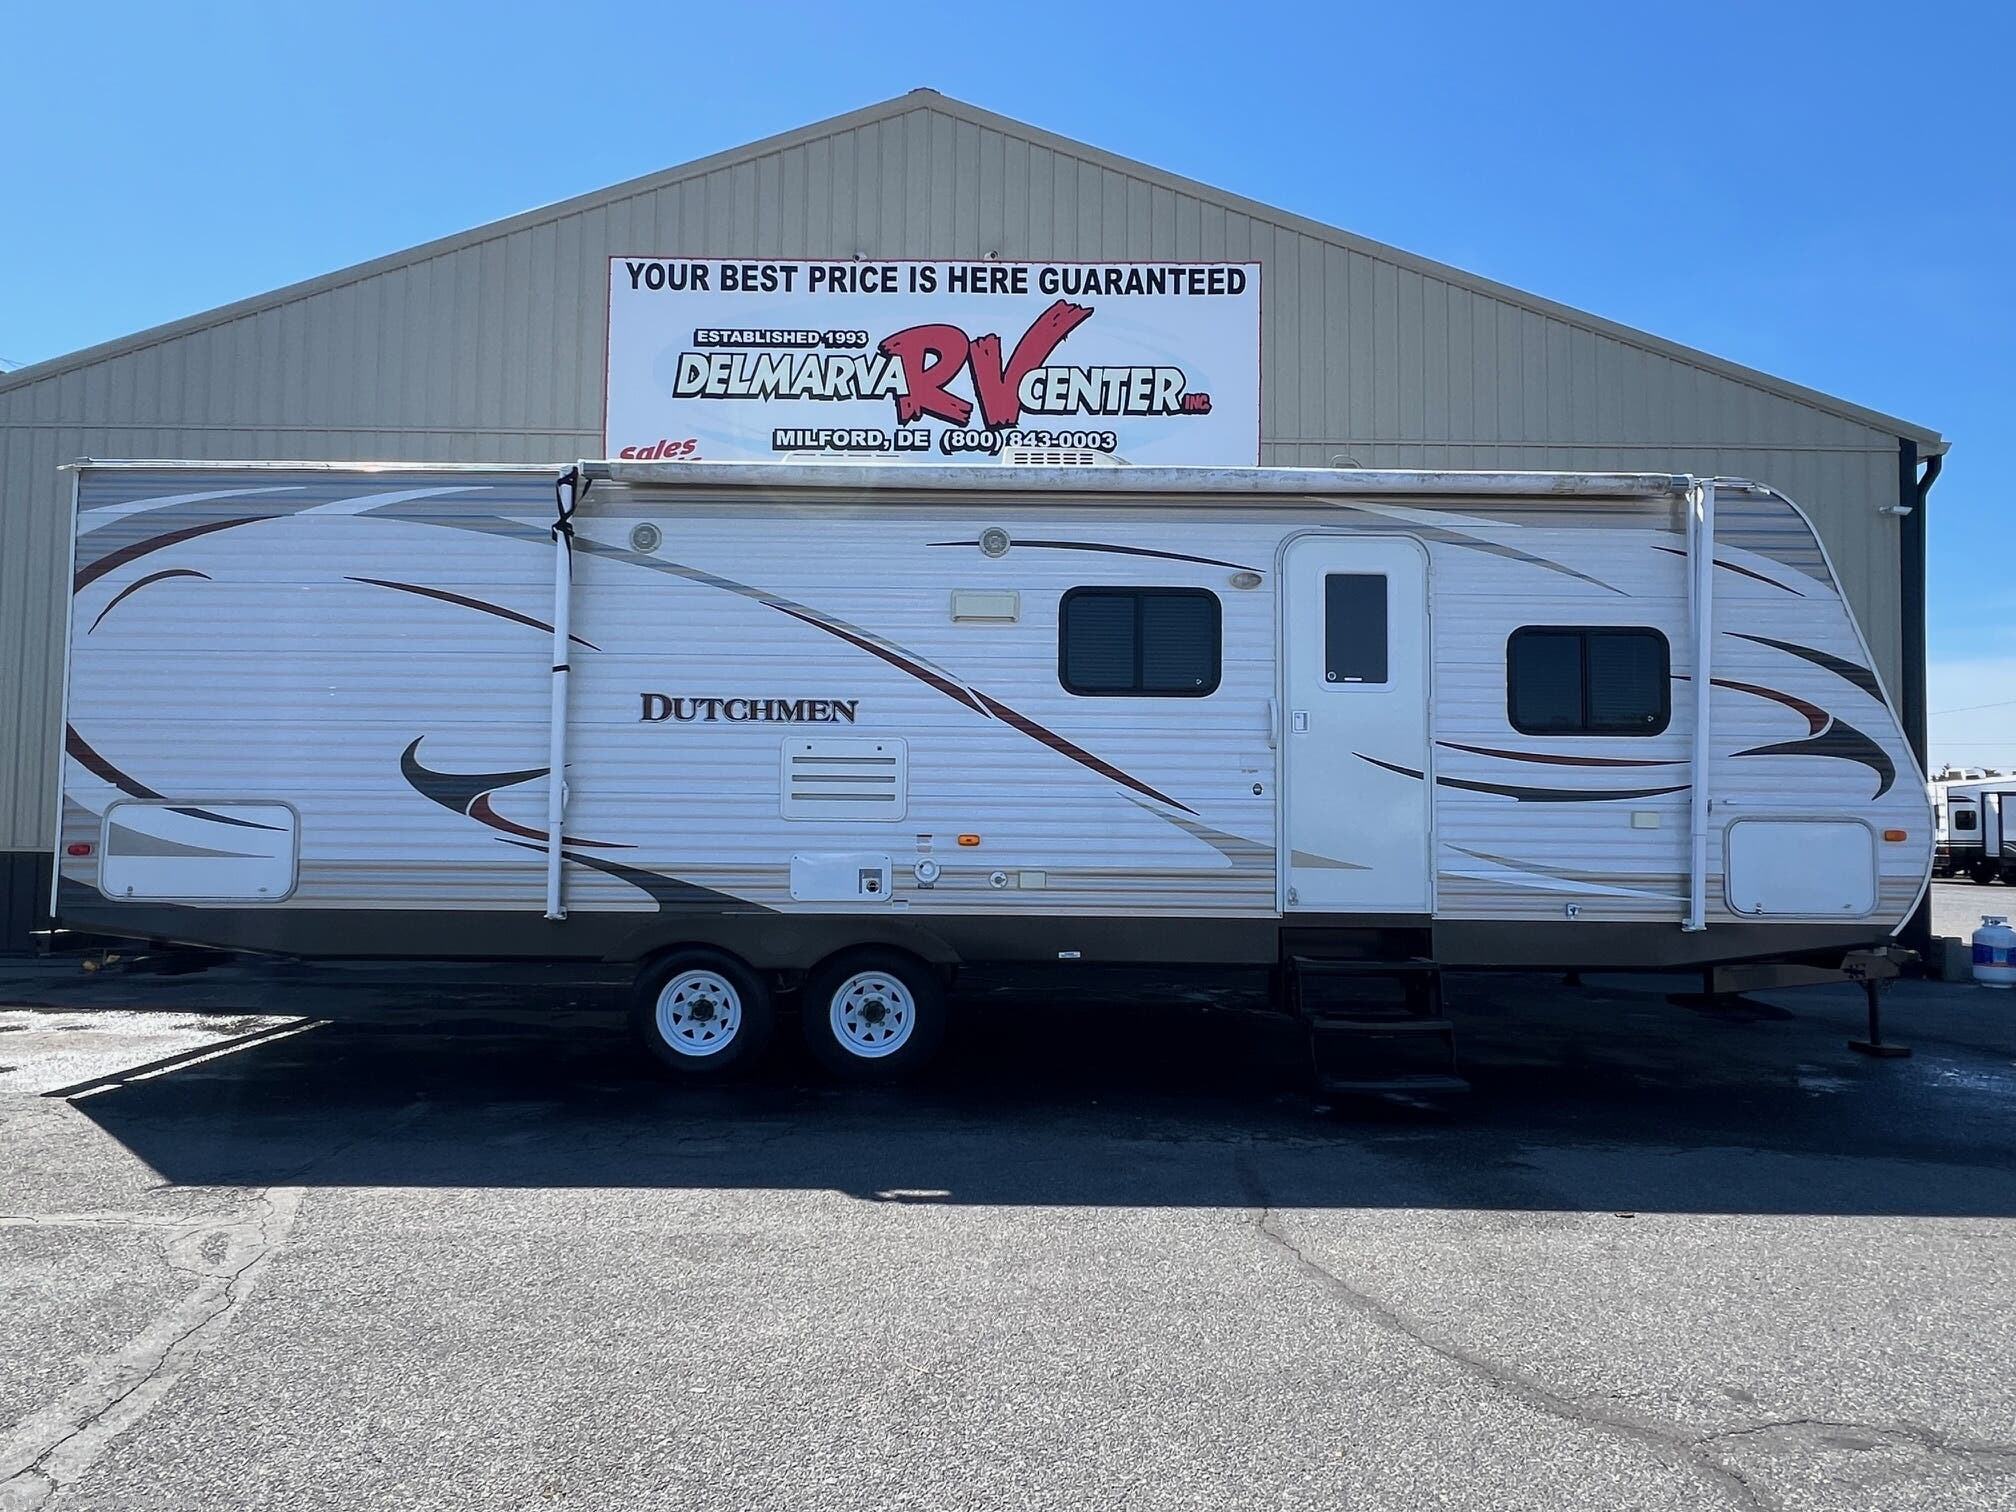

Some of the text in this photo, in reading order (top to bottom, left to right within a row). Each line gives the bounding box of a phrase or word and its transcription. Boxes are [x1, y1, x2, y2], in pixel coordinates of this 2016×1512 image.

[626, 262, 1246, 295] YOUR BEST PRICE IS HERE GUARANTEED
[696, 330, 868, 345] ESTABLISHED 1993
[673, 352, 910, 399] DELMARVA
[878, 299, 1094, 429] RV
[1018, 367, 1186, 414] CENTER
[775, 429, 1117, 453] MILFORD, DE (800) 843-0003
